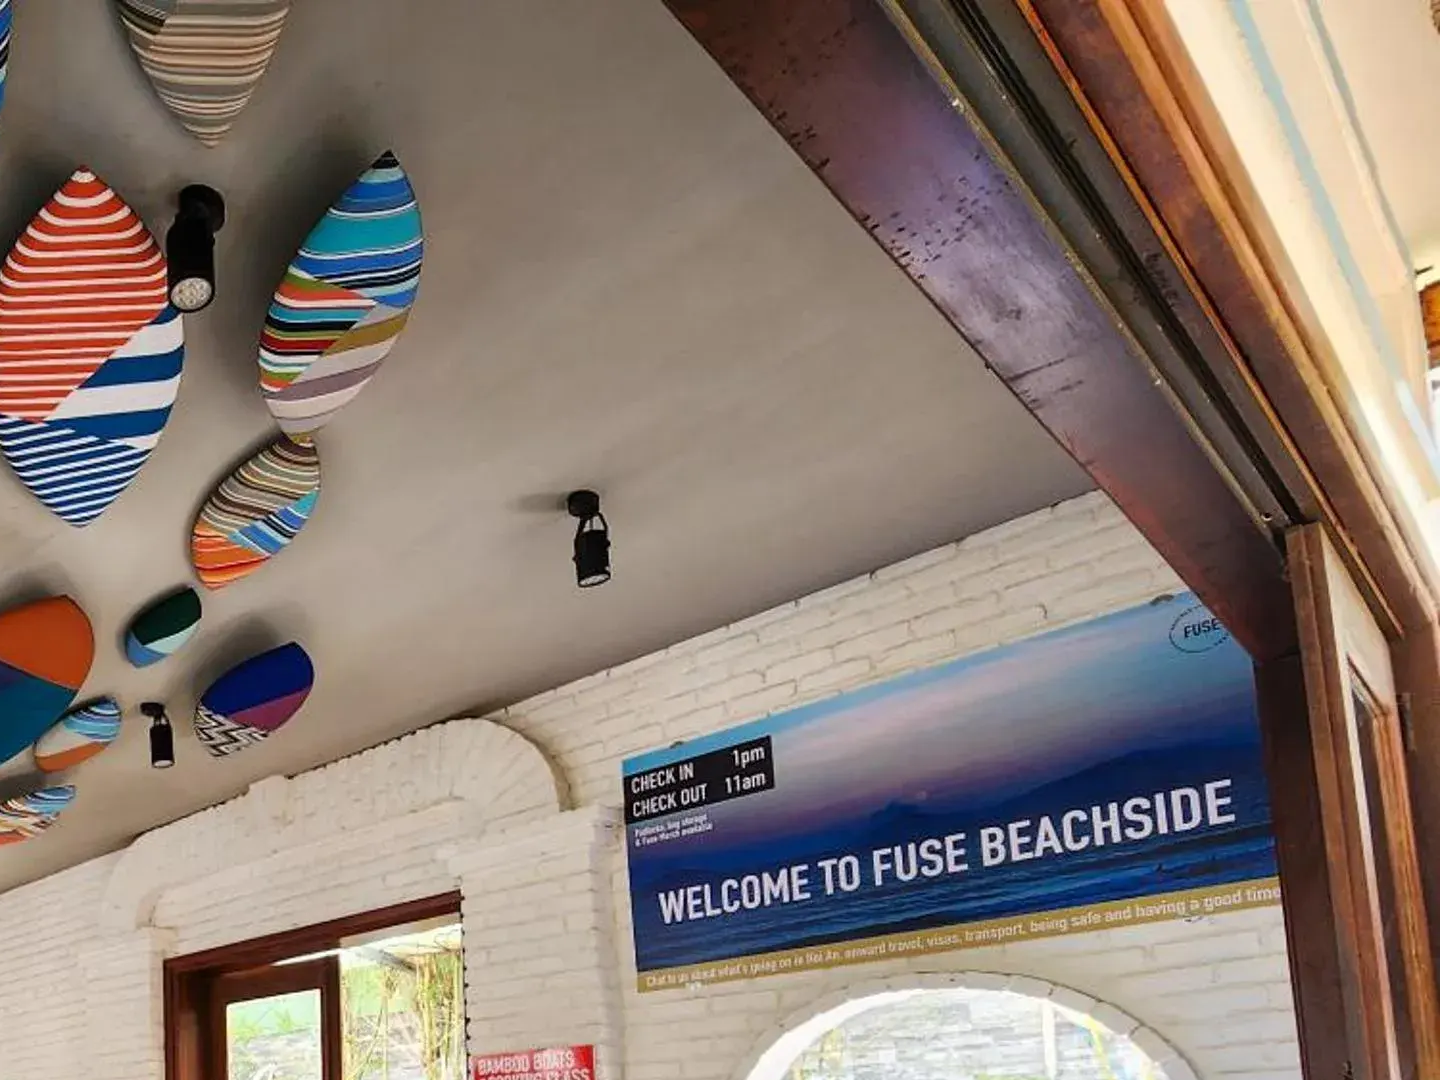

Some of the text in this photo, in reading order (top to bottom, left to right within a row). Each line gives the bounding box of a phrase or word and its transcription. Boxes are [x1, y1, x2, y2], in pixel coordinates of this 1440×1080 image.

[1184, 617, 1221, 638] FUSE
[631, 747, 765, 794] CHECK IN 1pm
[633, 772, 766, 818] CHECK OUT 11am
[658, 778, 1237, 925] WELCOME TO FUSE BEACHSIDE
[1030, 916, 1067, 933] being
[1071, 911, 1102, 927] safe
[1104, 905, 1133, 922] and
[1136, 899, 1186, 919] having
[1189, 898, 1201, 910] a
[1203, 889, 1242, 911] good
[477, 1049, 575, 1076] BAMBOO BOATS
